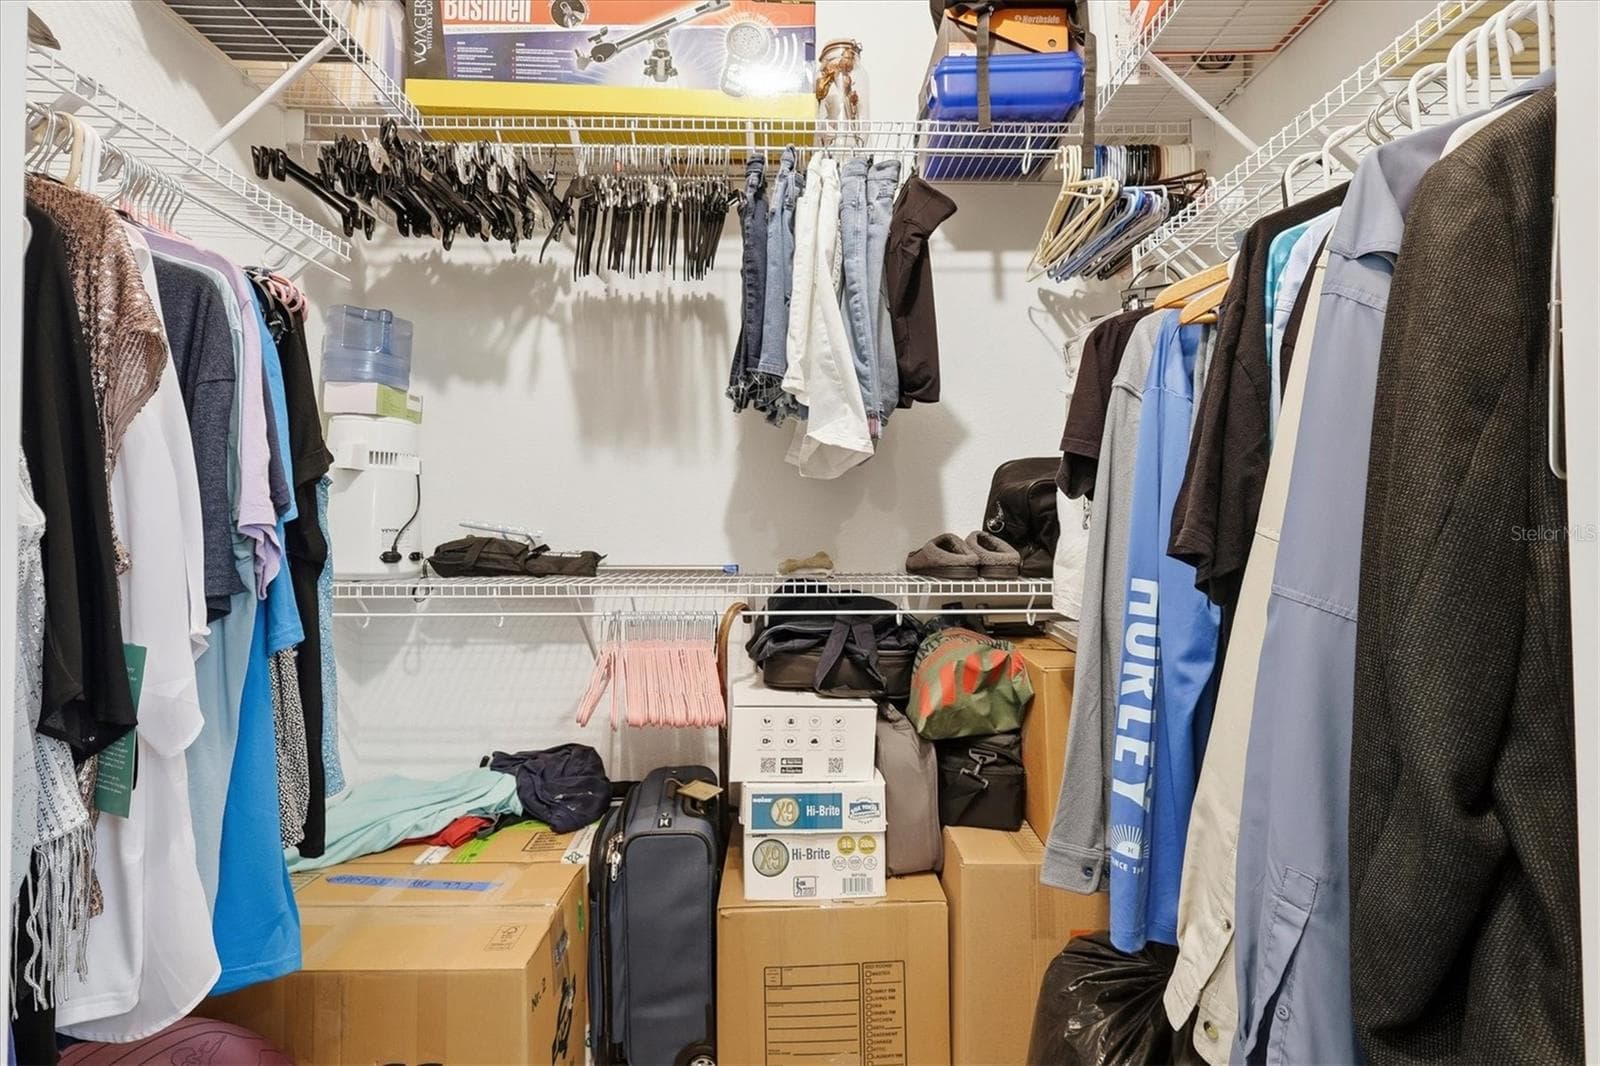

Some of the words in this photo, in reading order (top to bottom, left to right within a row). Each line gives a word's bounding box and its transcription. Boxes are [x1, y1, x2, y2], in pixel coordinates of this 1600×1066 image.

[414, 0, 427, 65] VOYAGER
[806, 805, 840, 817] Hi-Brite
[792, 847, 831, 861] Hi-Brite
